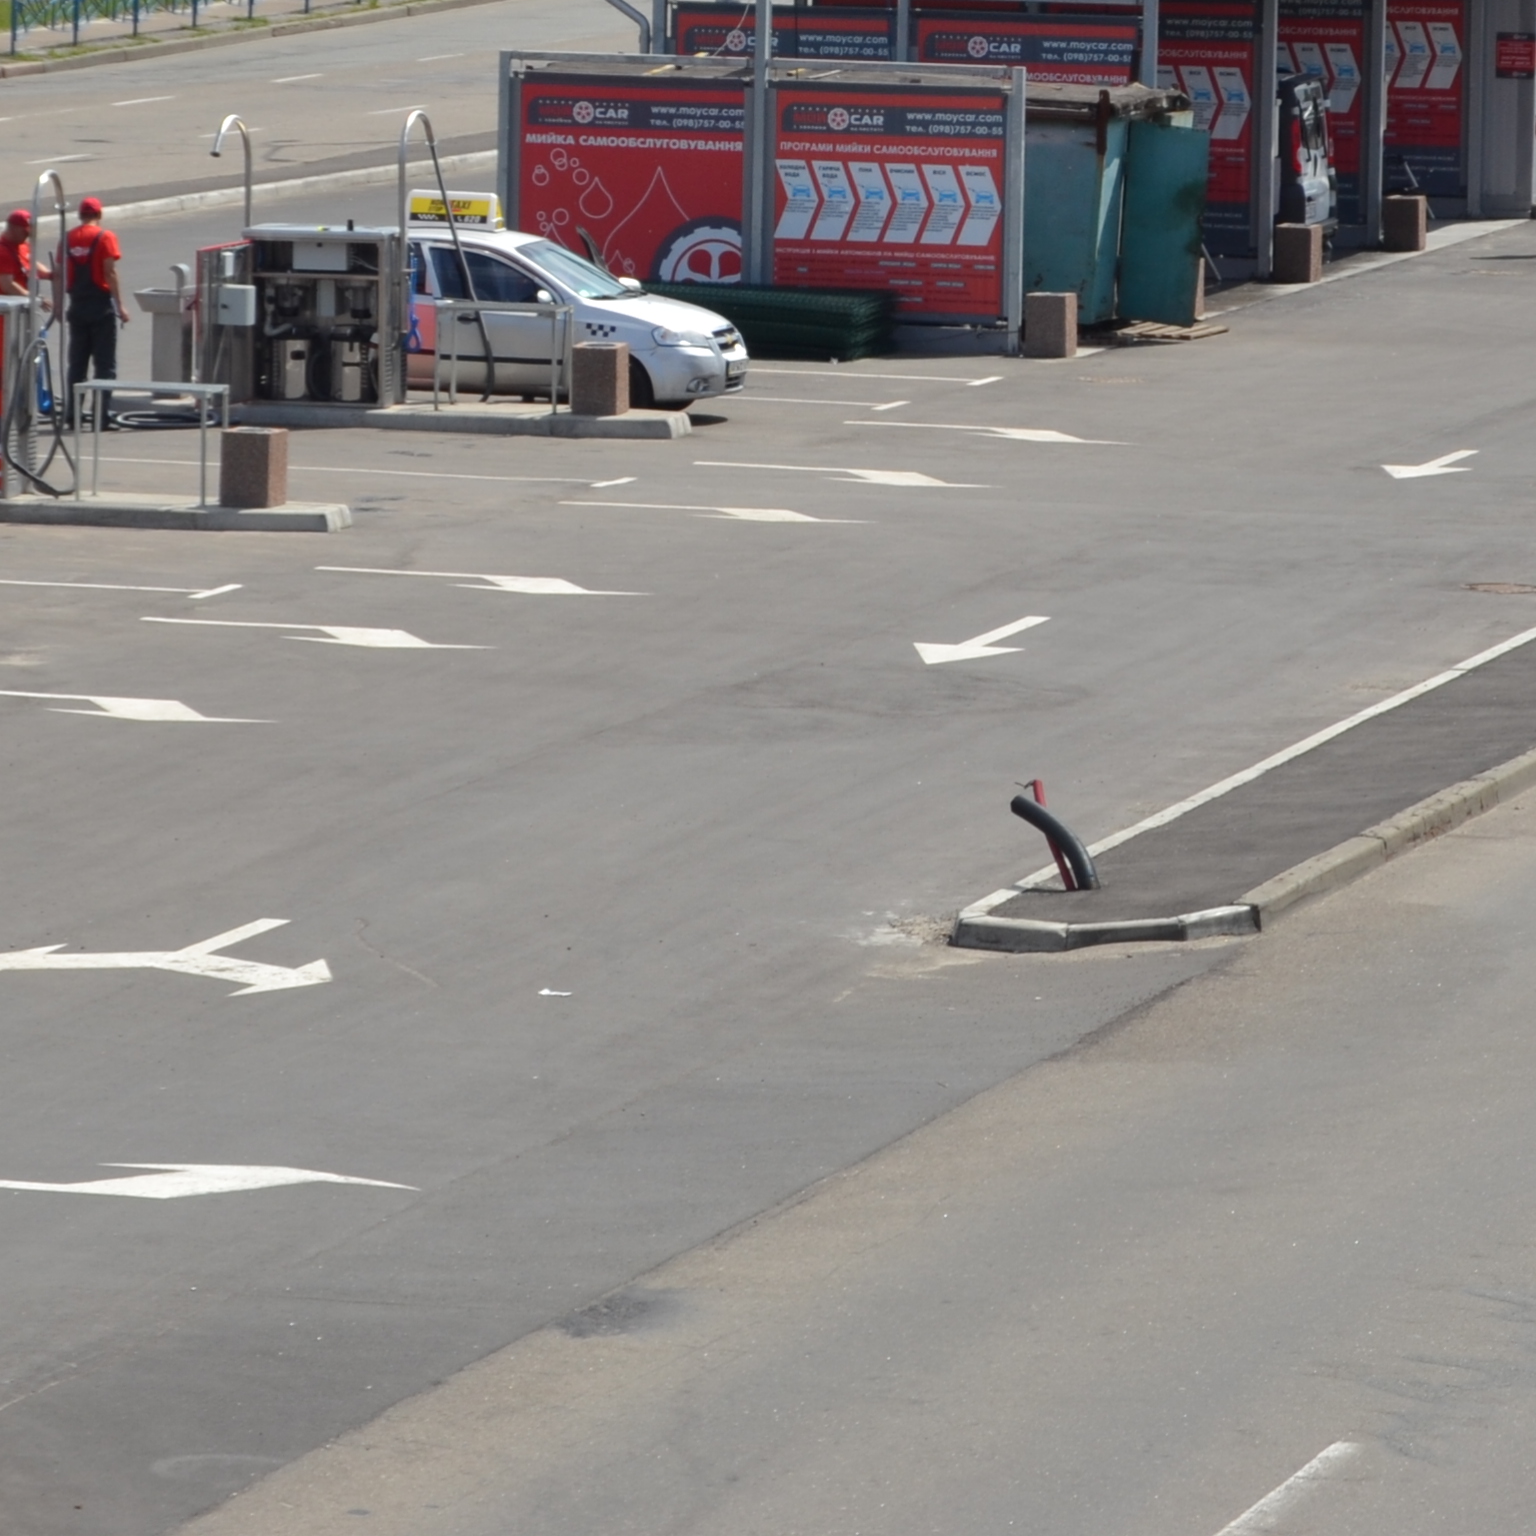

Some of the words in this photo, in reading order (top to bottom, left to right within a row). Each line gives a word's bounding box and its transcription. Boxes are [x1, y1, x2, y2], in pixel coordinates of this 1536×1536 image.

[798, 33, 888, 45] www.moycar.com
[819, 46, 889, 56] (098)757-00-55
[989, 42, 1022, 54] CAR
[1042, 40, 1133, 52] www.moycar.com
[594, 107, 629, 120] CAR
[906, 111, 1003, 124] www.moycar.com
[649, 119, 671, 127] тел.
[850, 114, 885, 126] CAR
[905, 125, 926, 133] тел.
[928, 125, 1004, 136] (098)757-00-55
[525, 132, 576, 146] МИЙКА
[578, 135, 744, 152] САМООБСЛУГОВУВАННЯ
[780, 141, 833, 152] ПРОГРАМИ
[835, 142, 871, 153] МИЙКИ
[873, 145, 998, 158] САМООБСЛУГОВУВАННЯ
